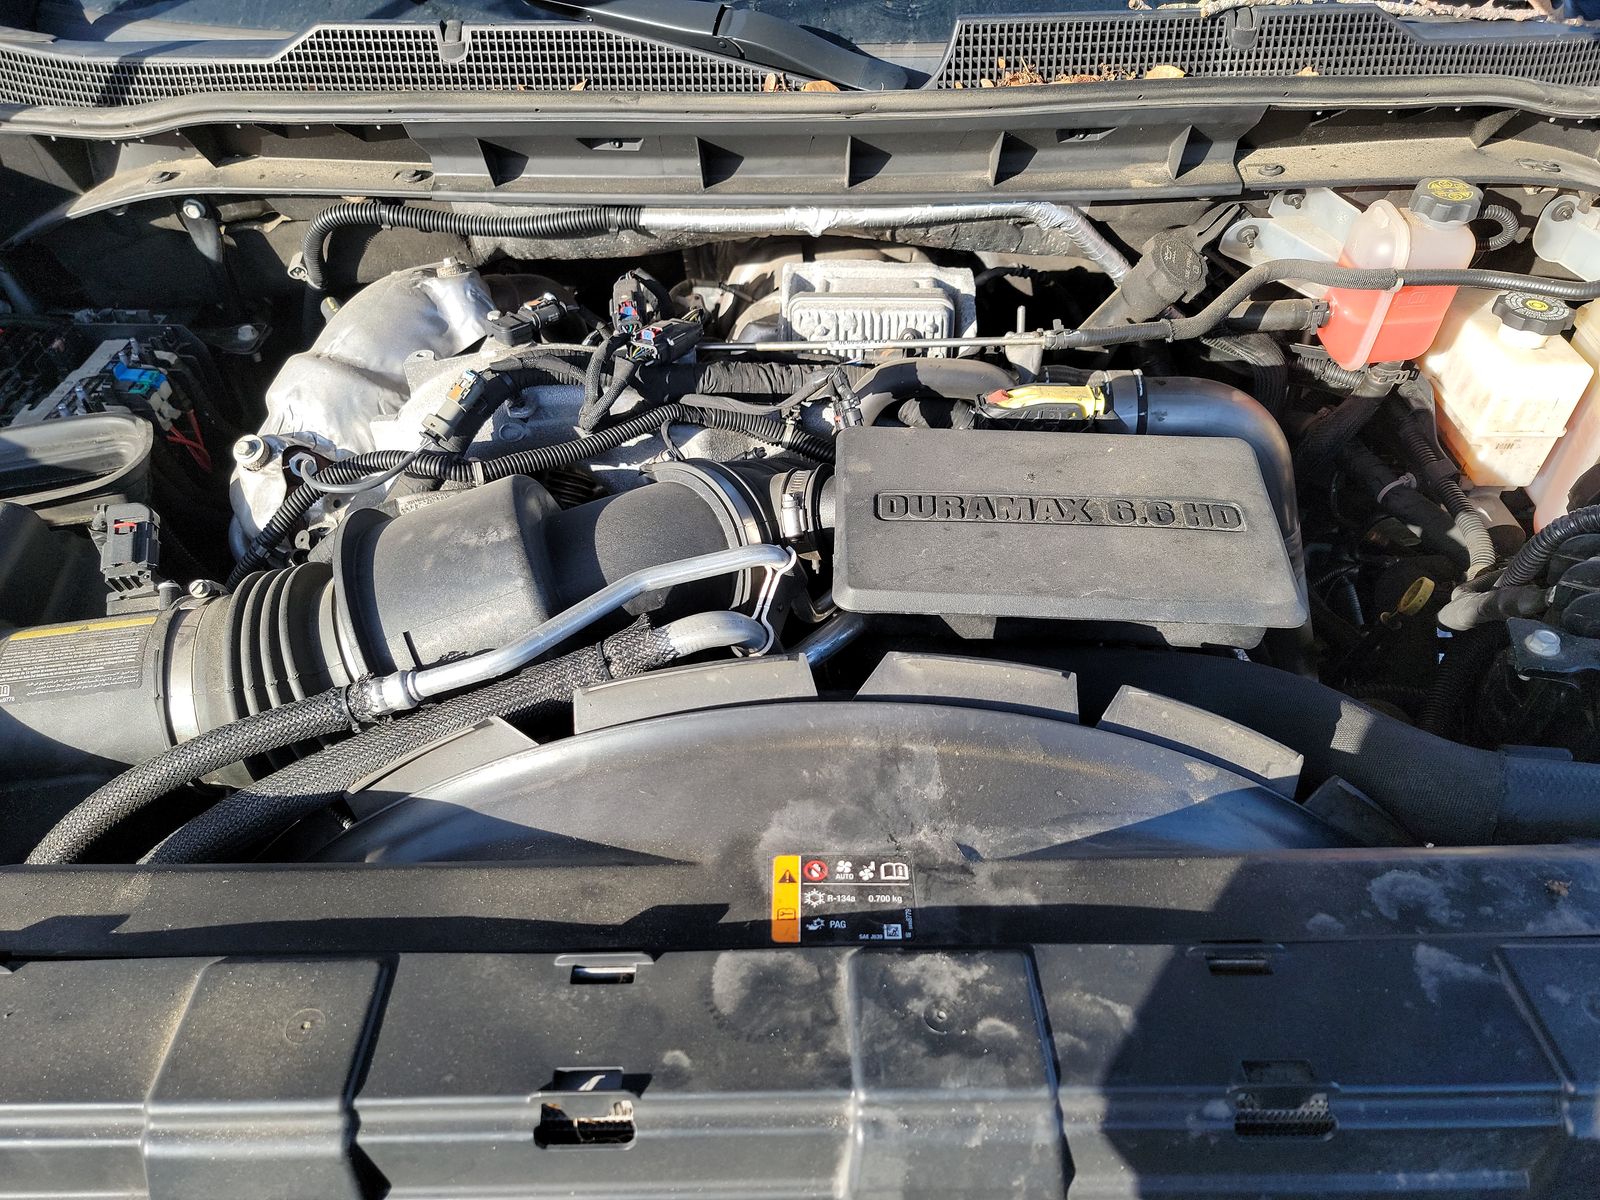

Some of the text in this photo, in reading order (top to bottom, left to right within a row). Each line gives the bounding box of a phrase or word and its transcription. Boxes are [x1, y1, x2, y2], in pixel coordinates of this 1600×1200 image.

[879, 494, 1244, 530] DURAMAX 6.6 HD
[827, 894, 903, 904] R-134a 0.700 kg
[829, 920, 847, 929] PAG
